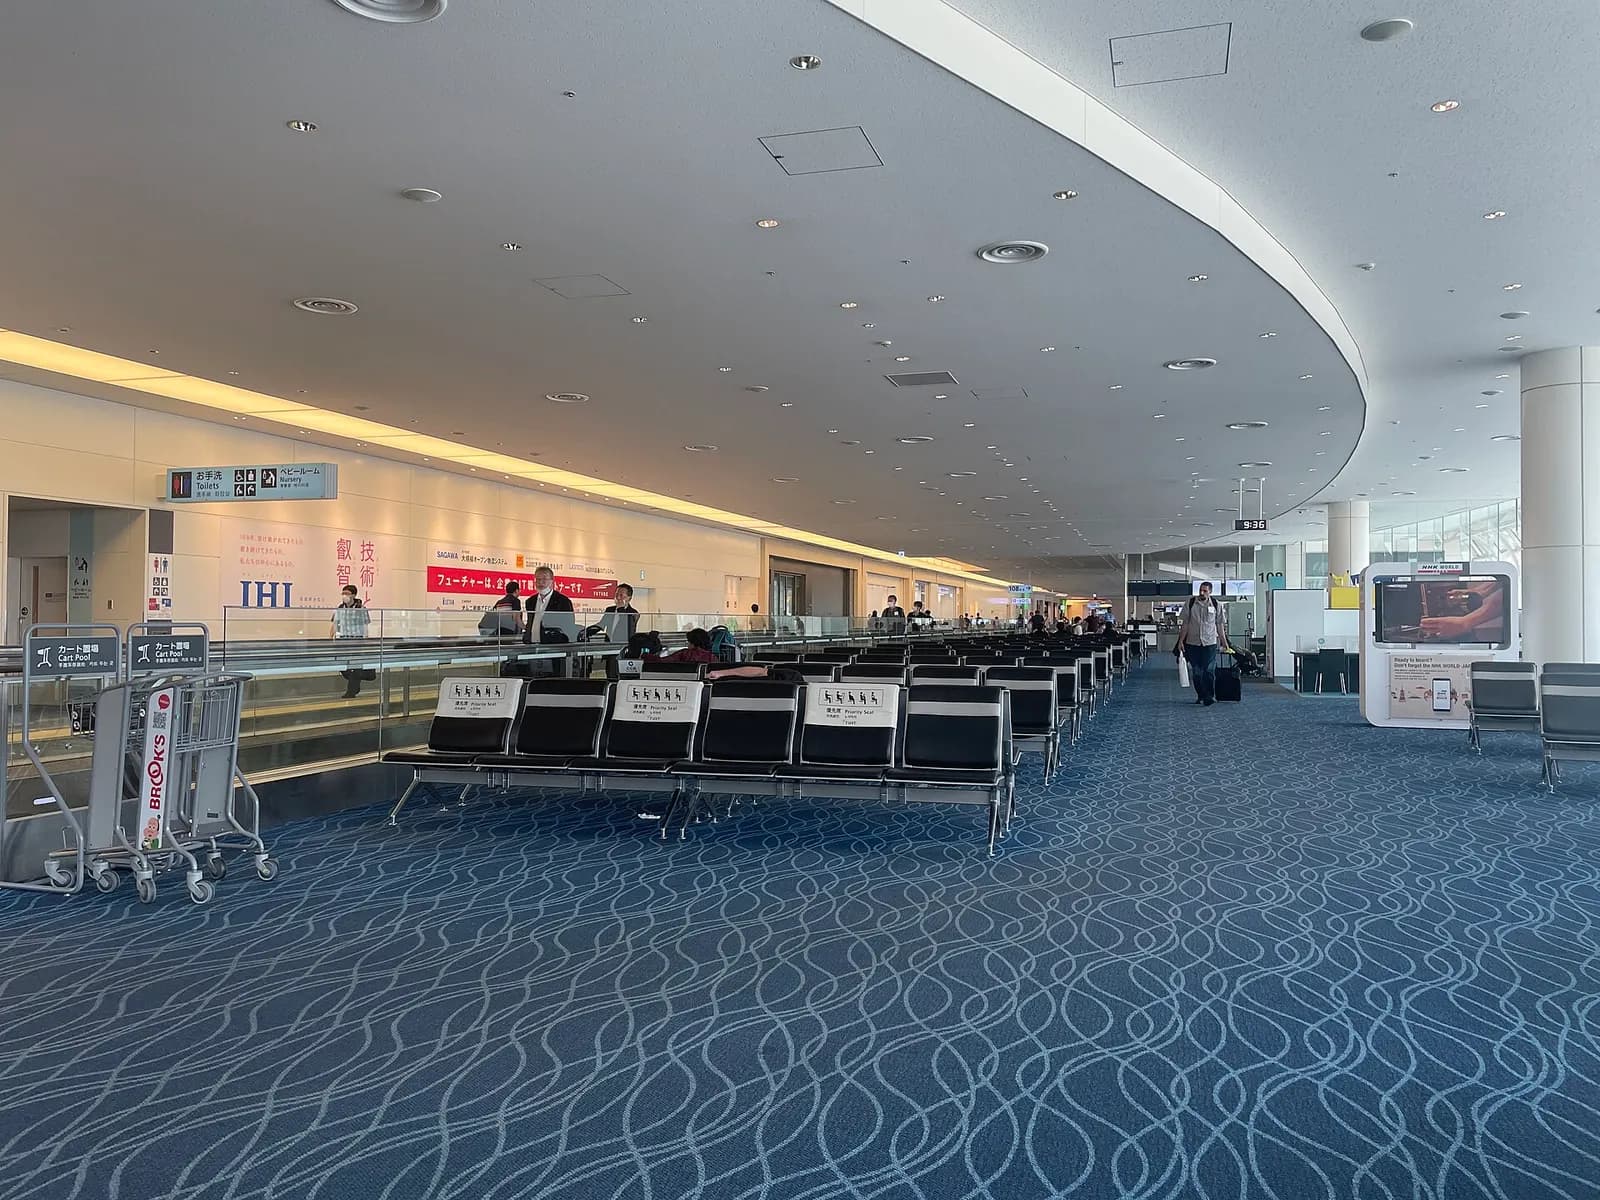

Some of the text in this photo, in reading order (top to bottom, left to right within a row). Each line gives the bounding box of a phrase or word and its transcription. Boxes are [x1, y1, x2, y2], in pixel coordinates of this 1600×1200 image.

[280, 467, 320, 475] ベビールーム
[196, 471, 222, 480] お手洗
[280, 476, 301, 484] Nursery
[196, 482, 220, 490] Toilets
[1243, 521, 1265, 529] 9:36
[437, 551, 458, 559] SAGAWA
[240, 580, 293, 608] IHI
